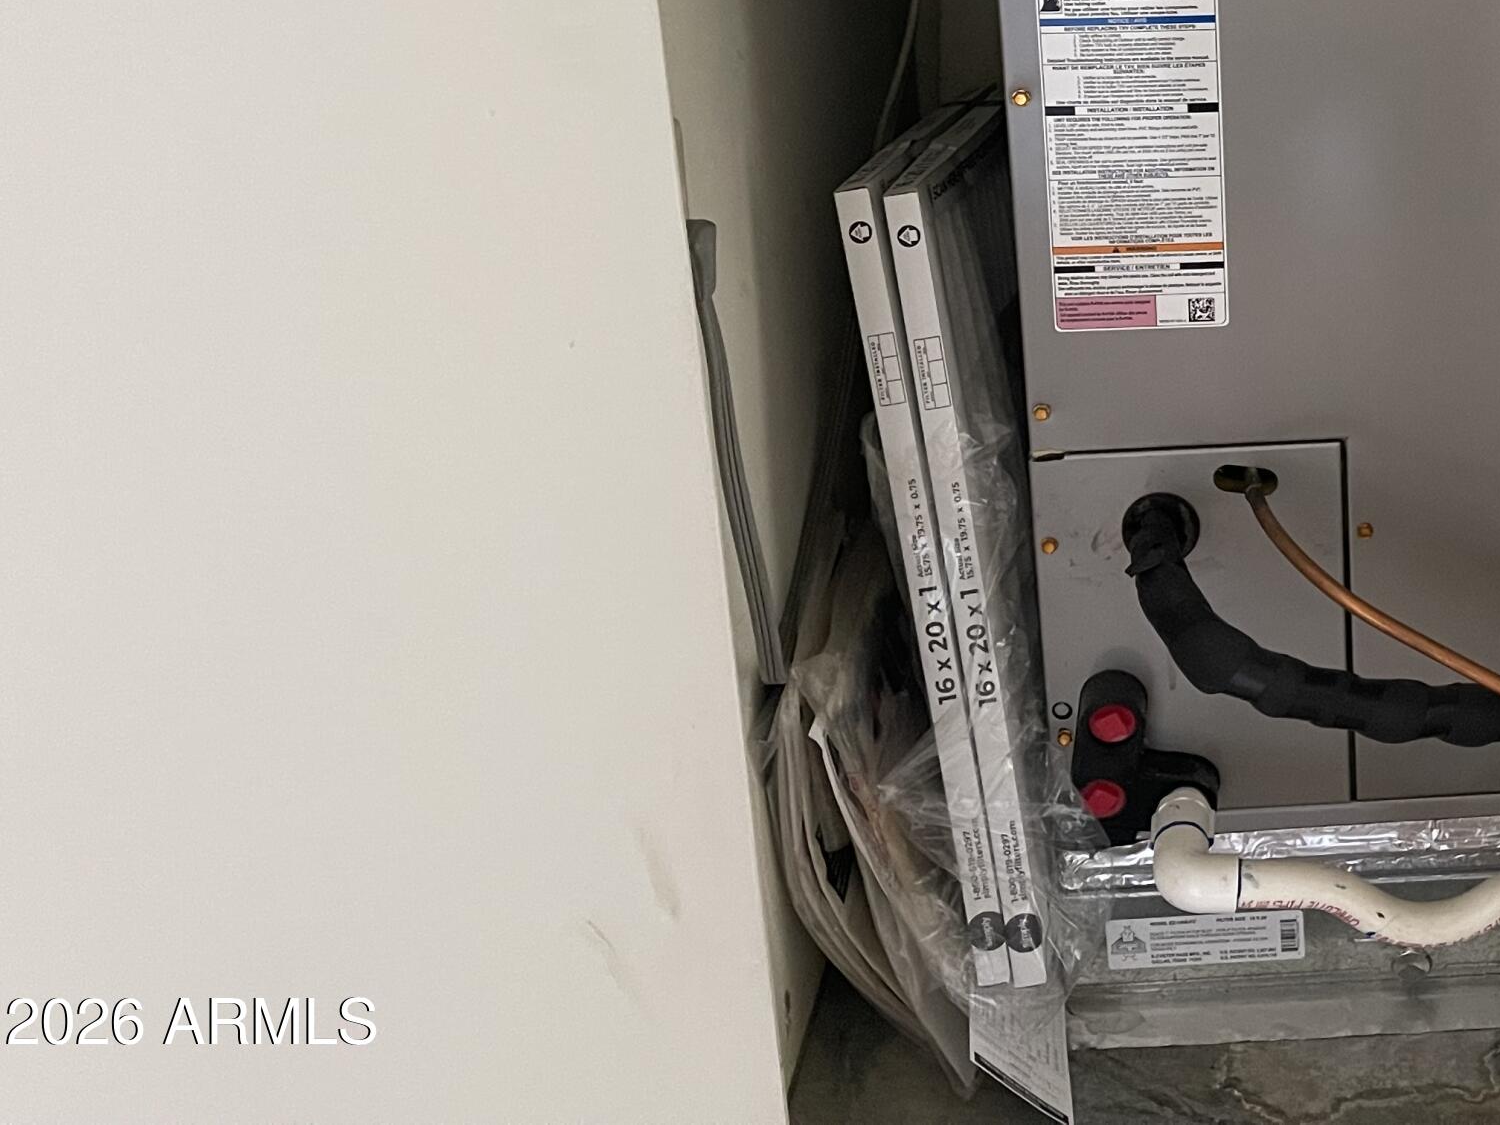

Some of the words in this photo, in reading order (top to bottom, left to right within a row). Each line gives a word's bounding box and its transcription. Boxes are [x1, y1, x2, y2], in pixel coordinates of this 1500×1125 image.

[908, 478, 918, 499] 0.75
[952, 481, 962, 503] 0.75
[957, 517, 968, 541] 19.75
[964, 556, 974, 580] 15.75
[918, 586, 937, 597] 1
[960, 588, 979, 599] 1
[927, 600, 942, 615] x
[968, 603, 983, 617] x
[925, 621, 949, 653] 20
[966, 624, 990, 655] 20
[937, 657, 952, 671] x
[977, 660, 993, 675] x
[935, 677, 957, 705] 16
[975, 681, 997, 708] 16
